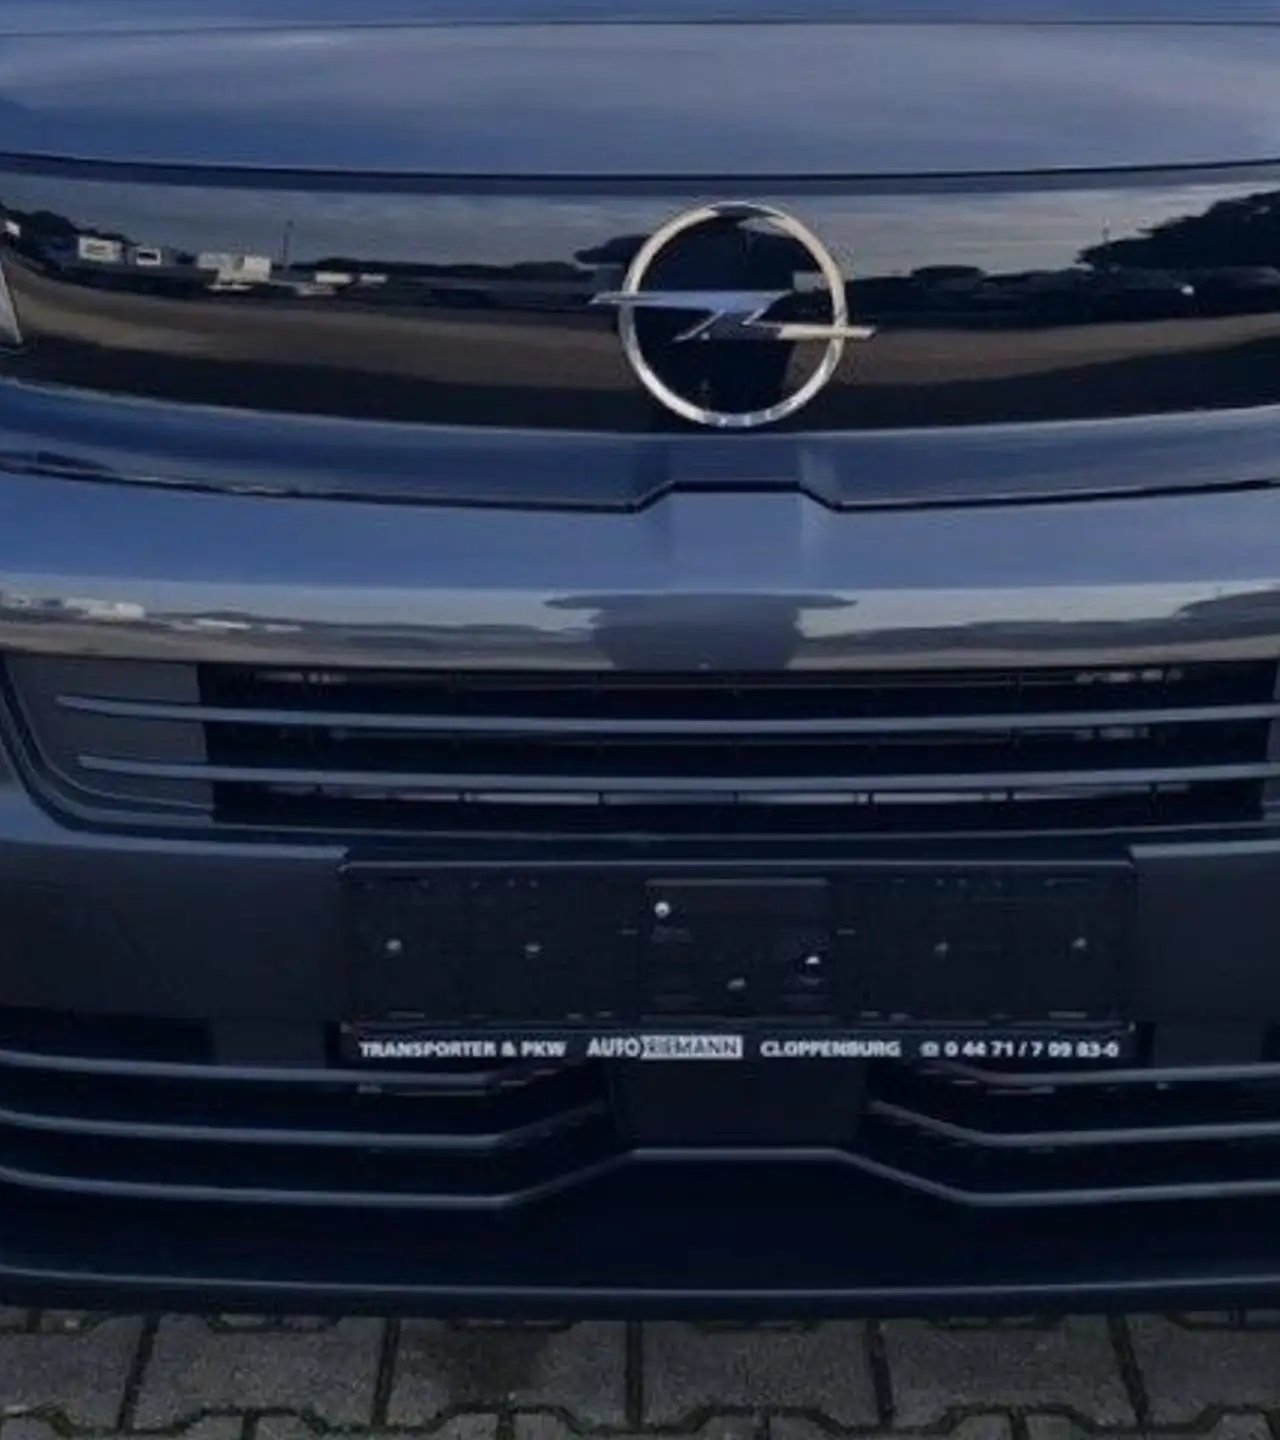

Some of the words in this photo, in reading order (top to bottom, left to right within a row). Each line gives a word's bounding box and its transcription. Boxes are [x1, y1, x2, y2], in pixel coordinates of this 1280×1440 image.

[360, 1041, 496, 1057] TRANSPORTER
[501, 1041, 517, 1057] &
[521, 1041, 567, 1057] PKW
[760, 1040, 902, 1057] CLOPPENBURG
